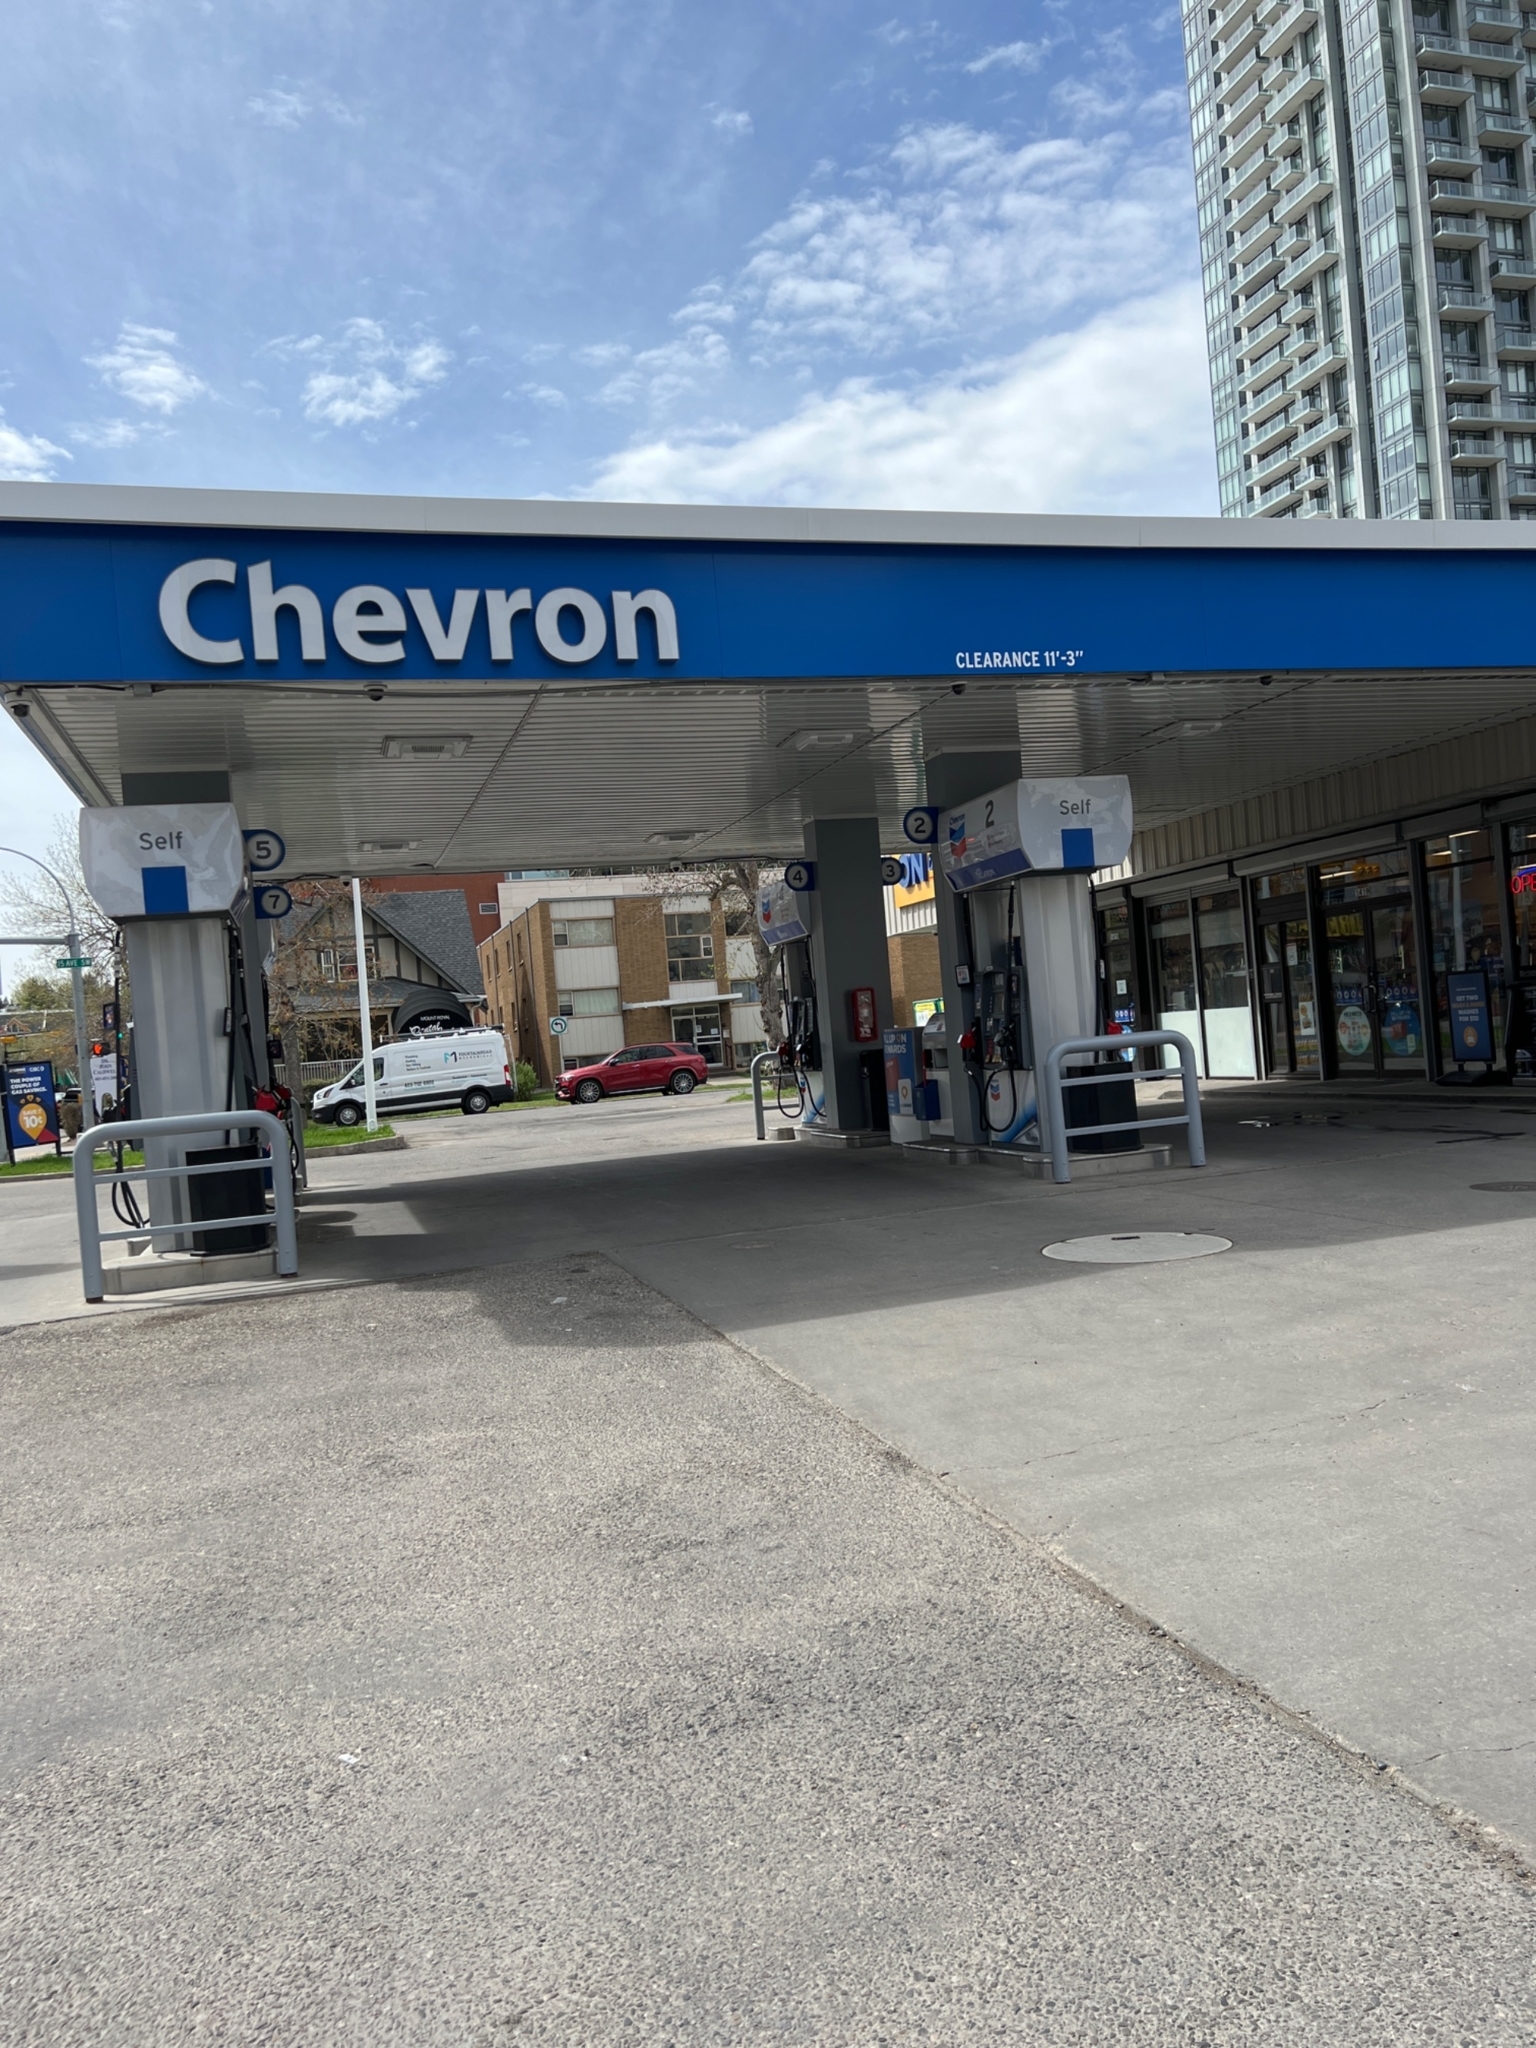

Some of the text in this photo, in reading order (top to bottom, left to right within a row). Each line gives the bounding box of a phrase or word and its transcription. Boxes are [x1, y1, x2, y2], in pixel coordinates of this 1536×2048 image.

[159, 557, 680, 664] Chevron
[955, 651, 1041, 668] CLEARANCE
[984, 799, 995, 829] 2
[1060, 798, 1091, 815] Self
[914, 817, 926, 834] 2
[139, 830, 183, 851] Self
[255, 840, 272, 860] 5
[792, 870, 803, 884] 4
[886, 864, 895, 878] 3
[268, 894, 280, 910] 7
